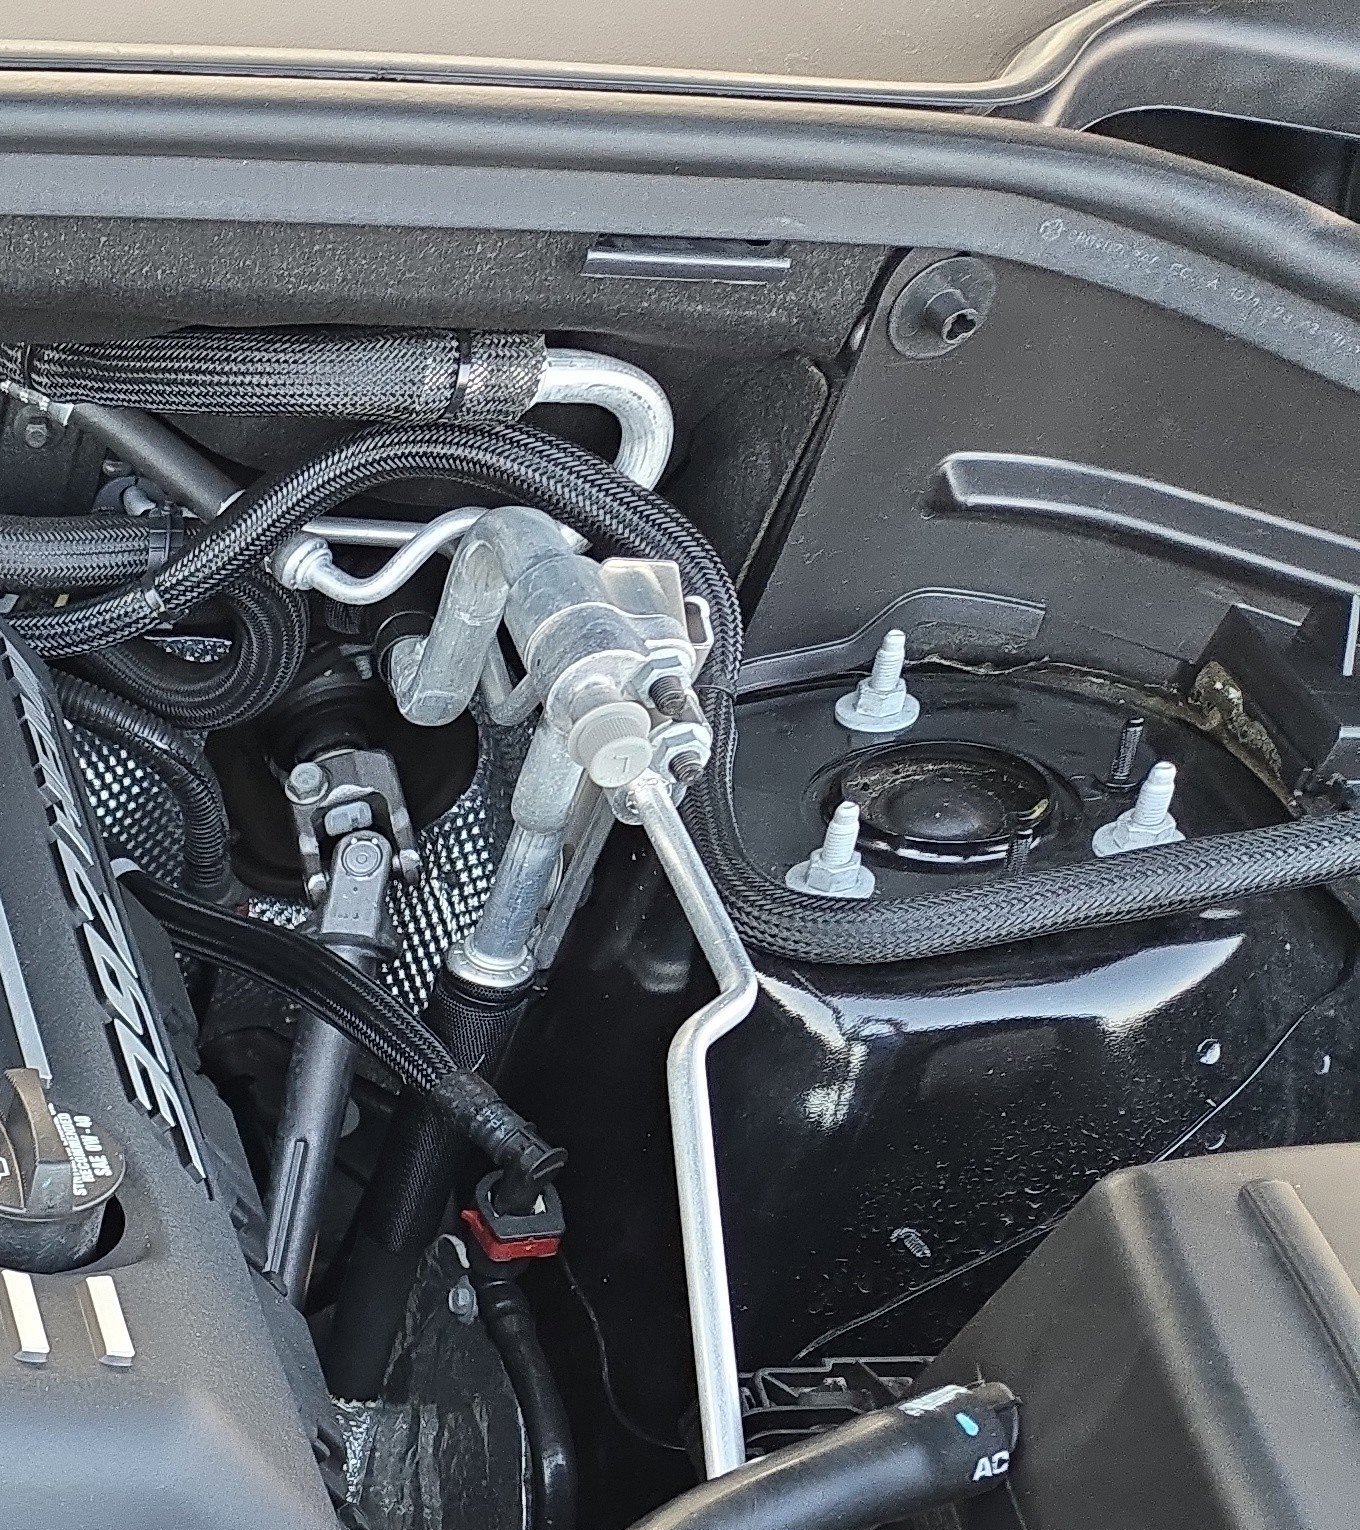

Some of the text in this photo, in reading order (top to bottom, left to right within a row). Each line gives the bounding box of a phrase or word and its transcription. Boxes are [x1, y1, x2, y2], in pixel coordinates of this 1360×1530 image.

[57, 838, 208, 1180] 392
[57, 1111, 96, 1183] RECOMMENDED
[89, 1154, 113, 1177] SAE
[972, 1450, 1010, 1481] AC
